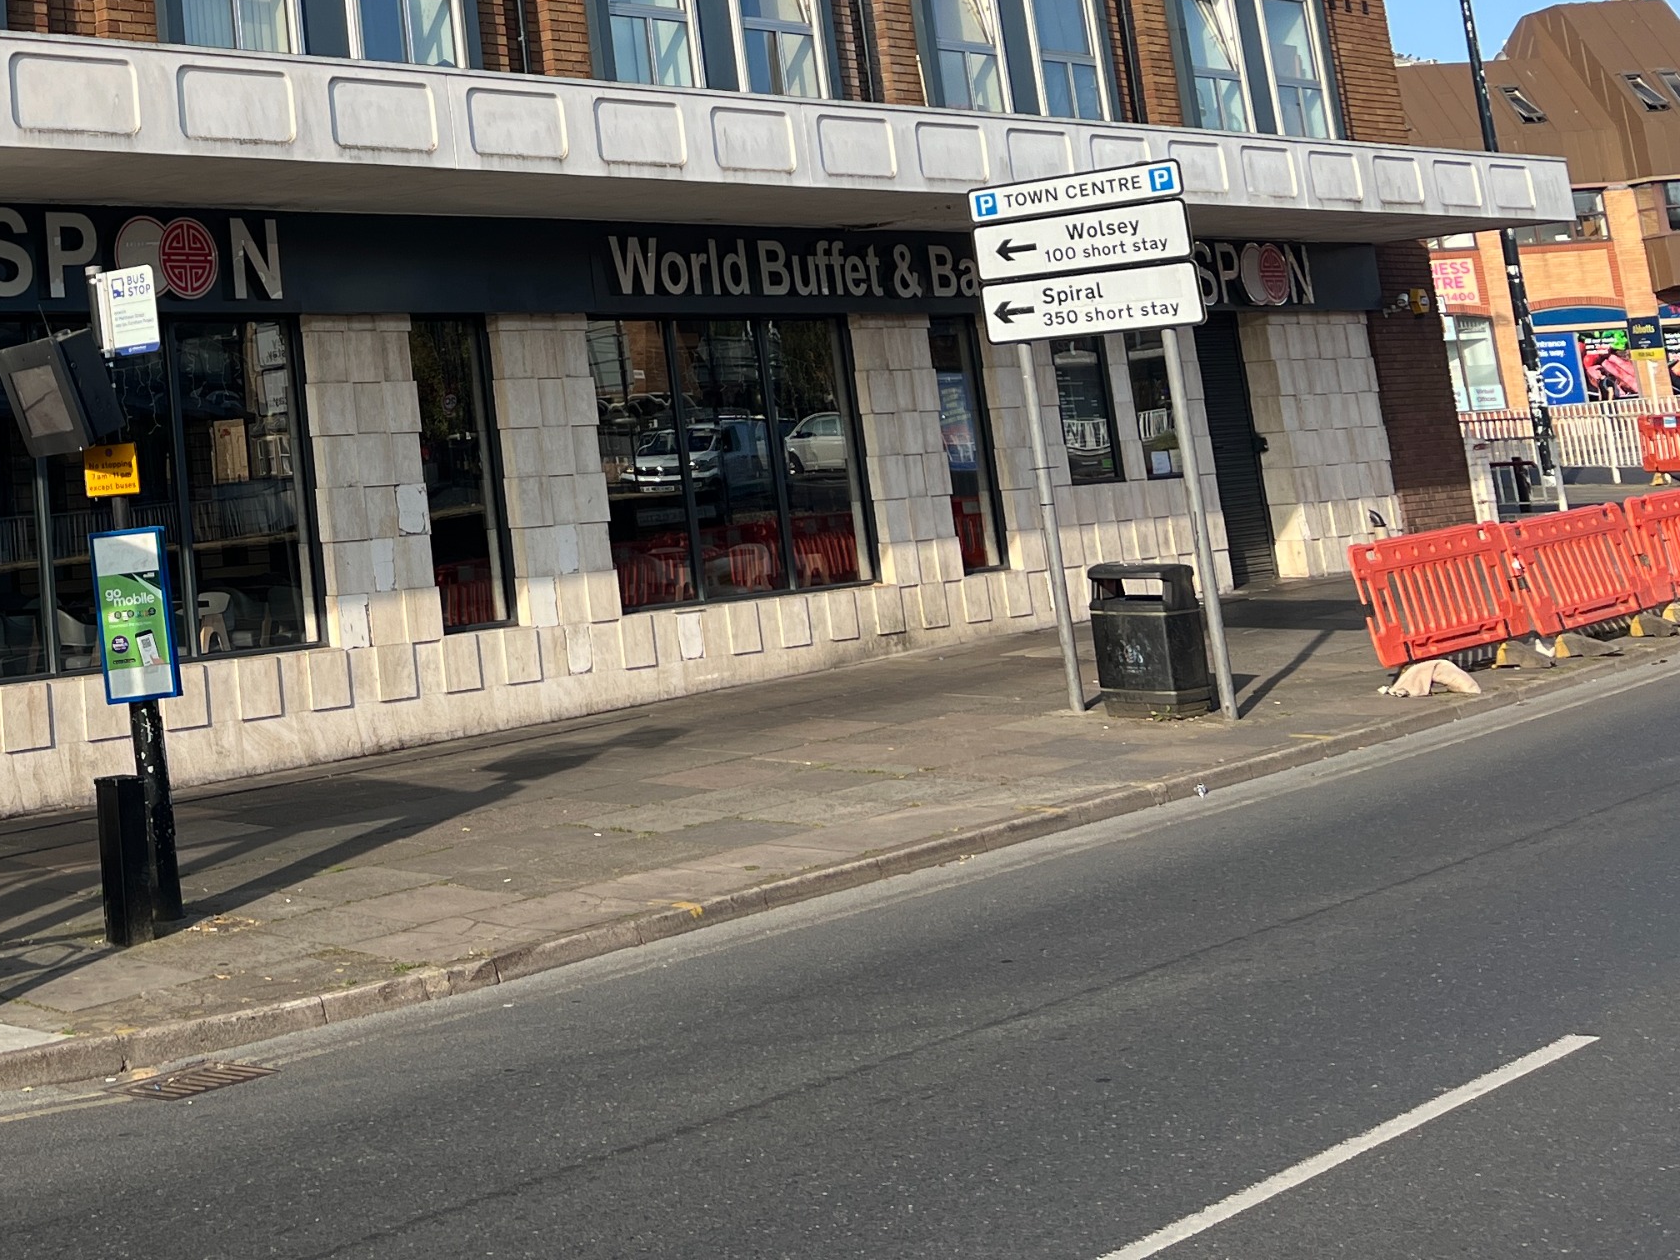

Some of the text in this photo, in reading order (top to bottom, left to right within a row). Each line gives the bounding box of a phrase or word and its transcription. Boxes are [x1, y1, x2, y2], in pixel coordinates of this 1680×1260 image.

[1004, 187, 1059, 208] TOWN
[1065, 175, 1143, 199] CENTRE
[1065, 219, 1140, 241] Wolsey
[1045, 237, 1168, 263] 100 short stay
[607, 235, 981, 298] World Buffet & Ba
[126, 273, 145, 286] BUS
[127, 283, 151, 297] STOP
[1042, 281, 1104, 306] Spiral
[1043, 301, 1180, 327] 350 short stay
[88, 460, 133, 470] No stopping
[89, 482, 137, 491] except buses
[105, 589, 121, 602] go
[113, 592, 155, 608] mobile
